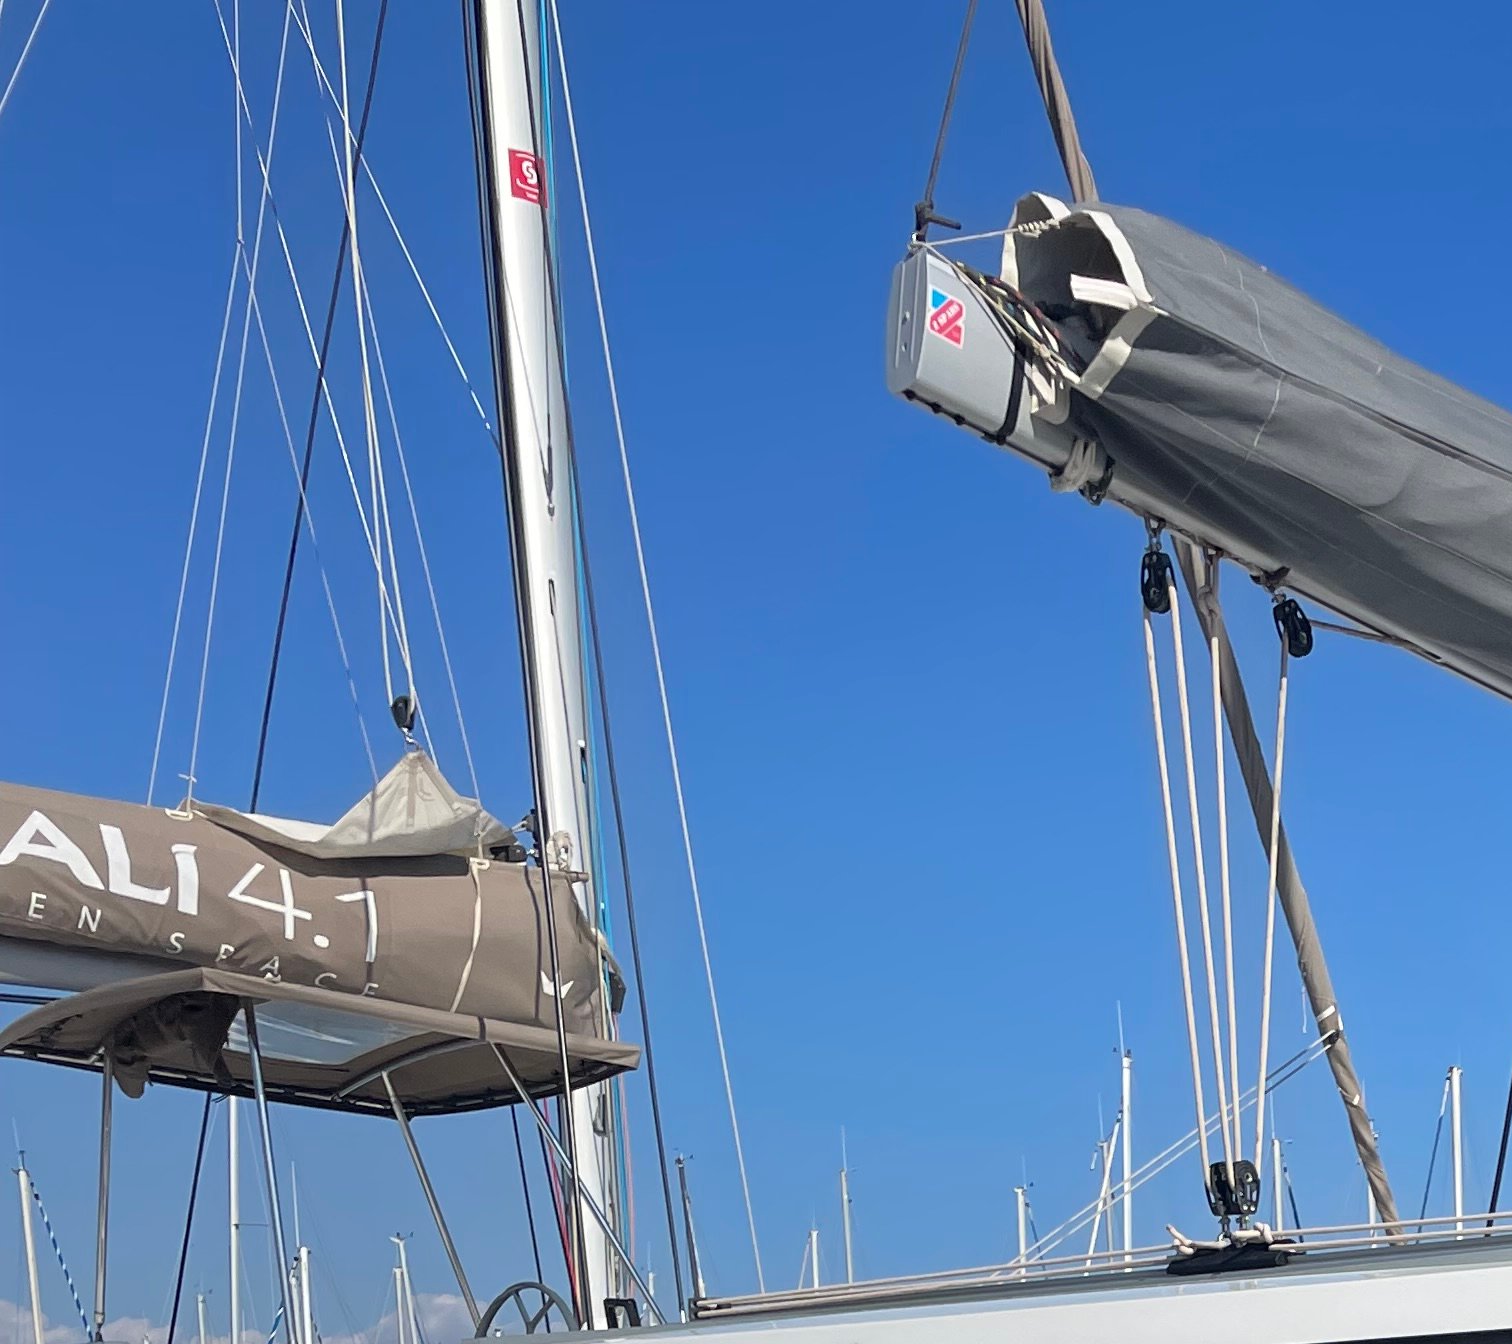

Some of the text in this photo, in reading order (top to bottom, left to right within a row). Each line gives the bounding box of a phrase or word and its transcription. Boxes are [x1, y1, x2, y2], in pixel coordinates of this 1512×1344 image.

[0, 810, 378, 962] ALI 4.1
[28, 891, 102, 932] EN
